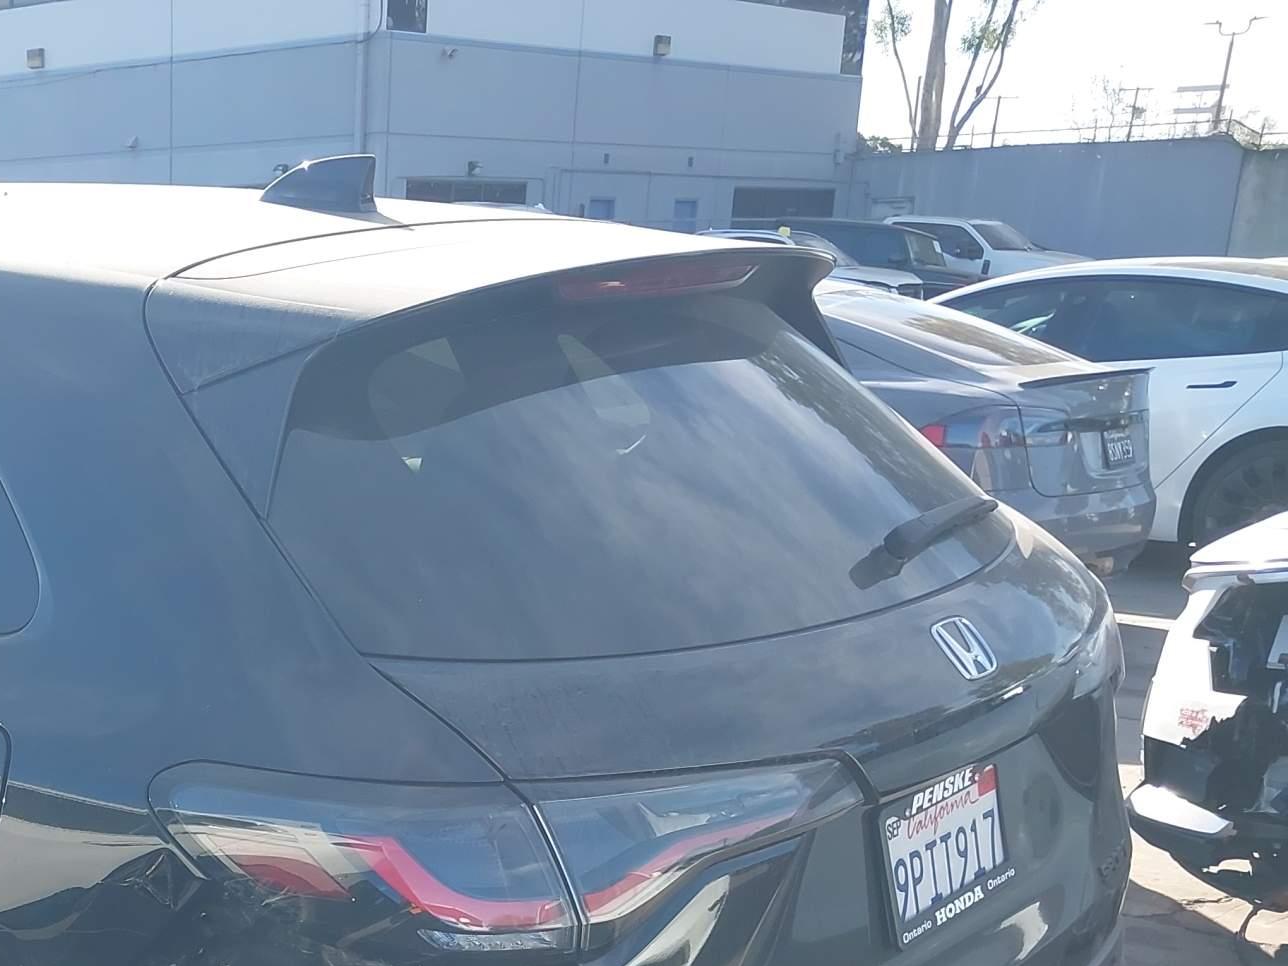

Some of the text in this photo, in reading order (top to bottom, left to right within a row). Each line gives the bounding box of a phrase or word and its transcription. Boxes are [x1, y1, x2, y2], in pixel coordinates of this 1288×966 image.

[906, 790, 979, 840] California
[911, 767, 974, 815] PENSKE
[887, 819, 902, 840] SEP
[902, 867, 1016, 944] Ontario HONDA Ontario
